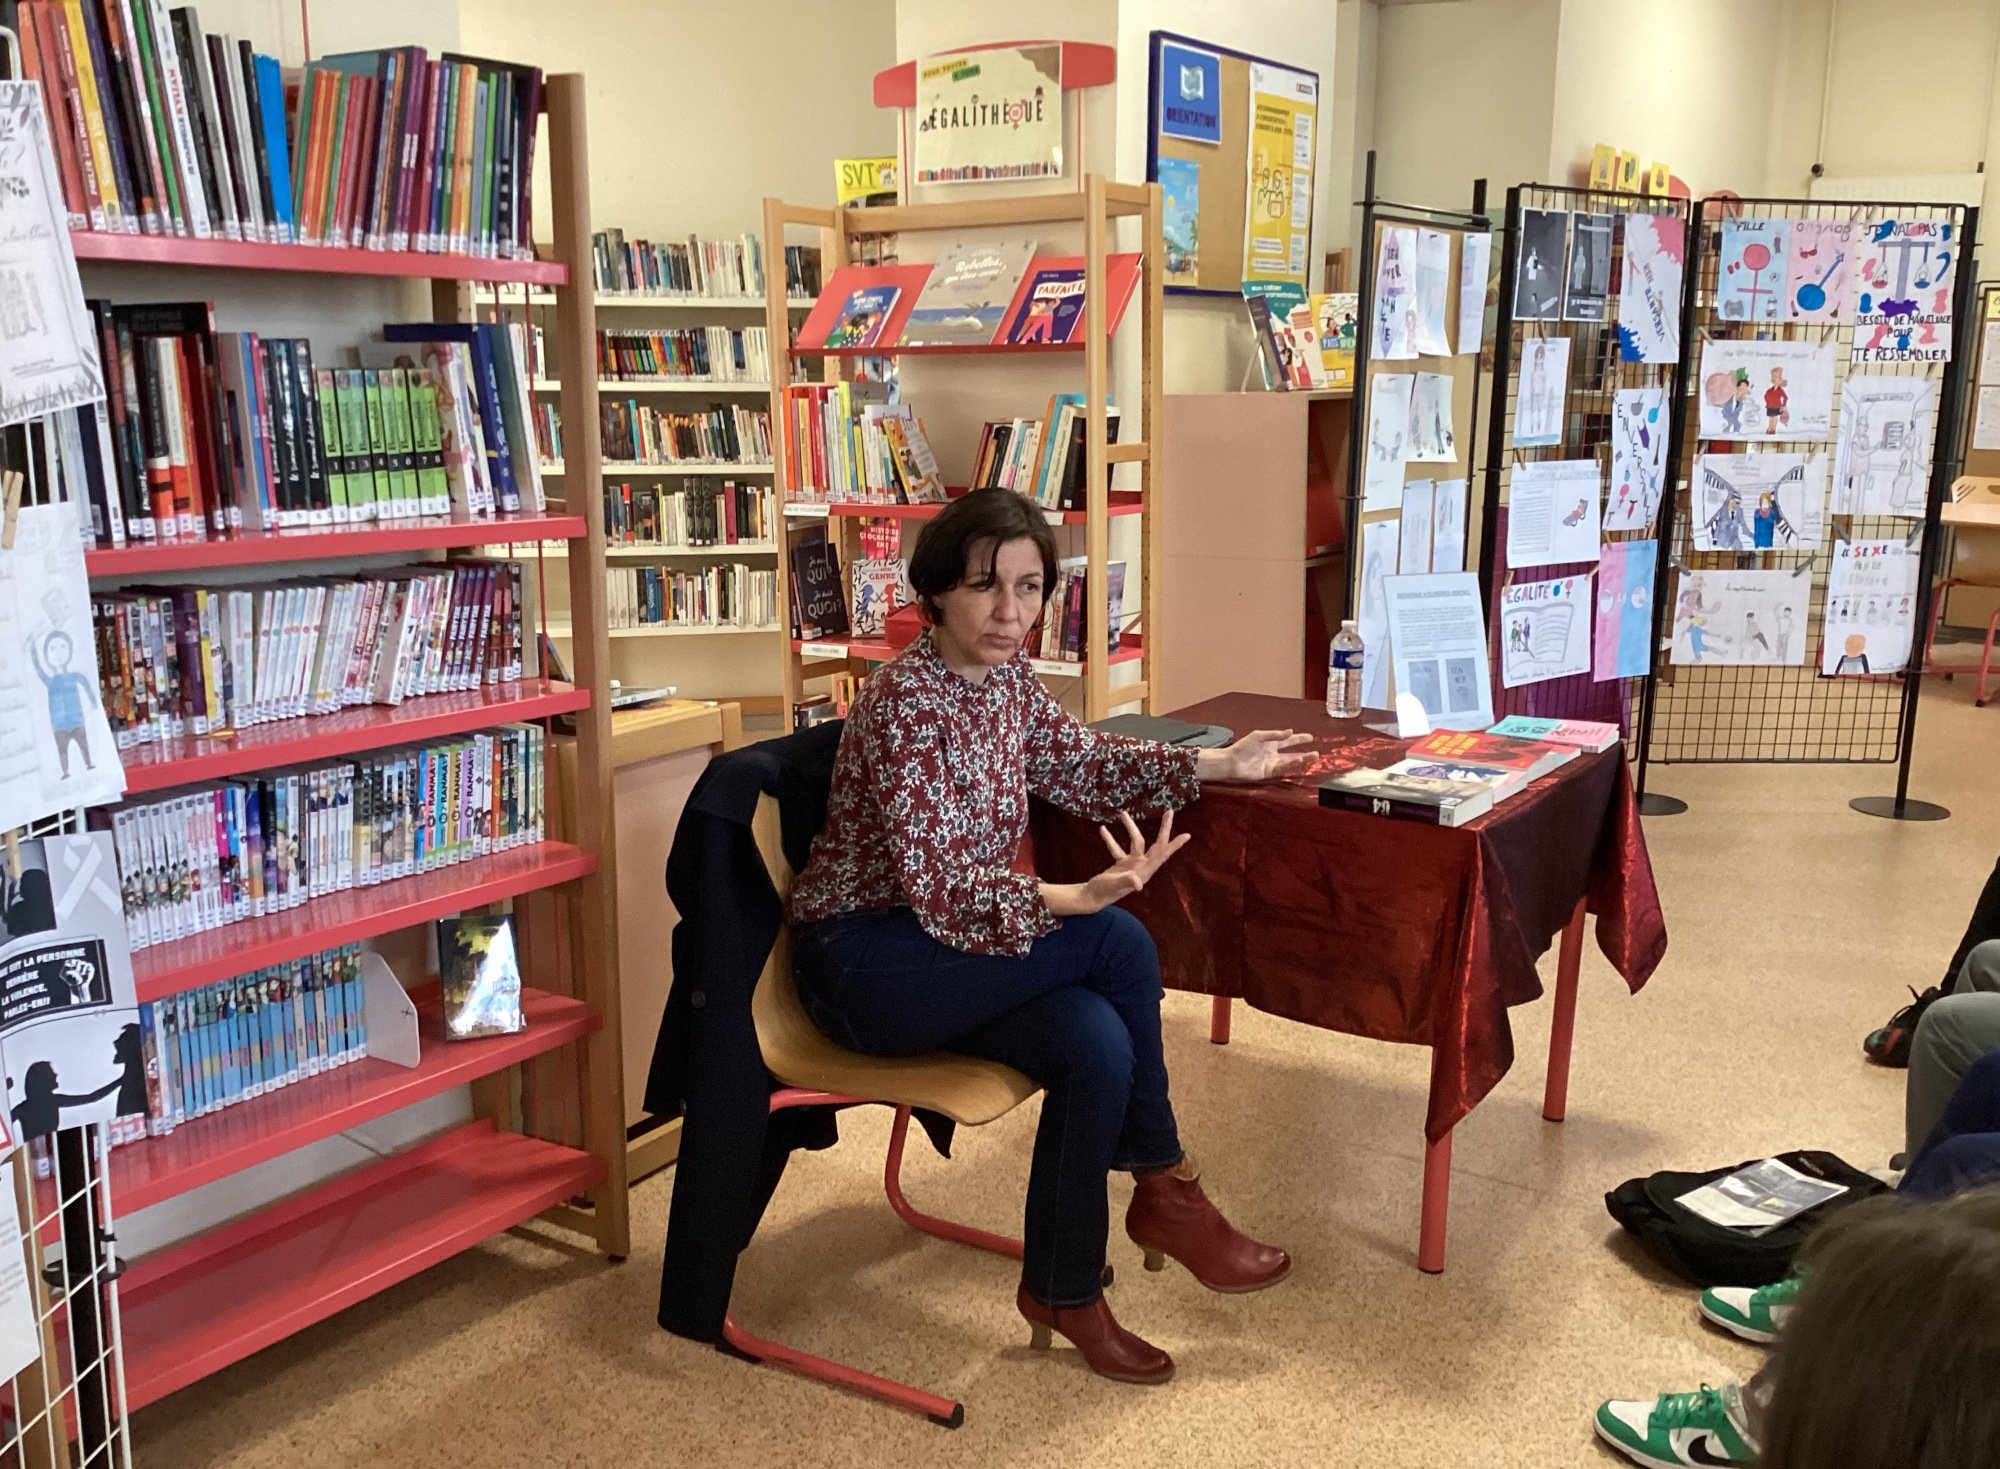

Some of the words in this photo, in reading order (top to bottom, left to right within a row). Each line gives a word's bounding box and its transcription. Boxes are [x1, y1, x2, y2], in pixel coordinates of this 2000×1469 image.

[1166, 107, 1216, 128] ORIENTATION
[843, 162, 875, 187] SVT
[1894, 315, 1905, 325] DE
[1887, 328, 1913, 338] POUR
[1853, 348, 1870, 361] TE
[869, 572, 896, 580] GENRE
[428, 767, 436, 806] RANMA
[453, 763, 461, 800] RANMA
[466, 759, 474, 797] RANMA
[1372, 798, 1391, 816] U4
[23, 957, 35, 968] LA
[36, 947, 86, 965] PERSONNE
